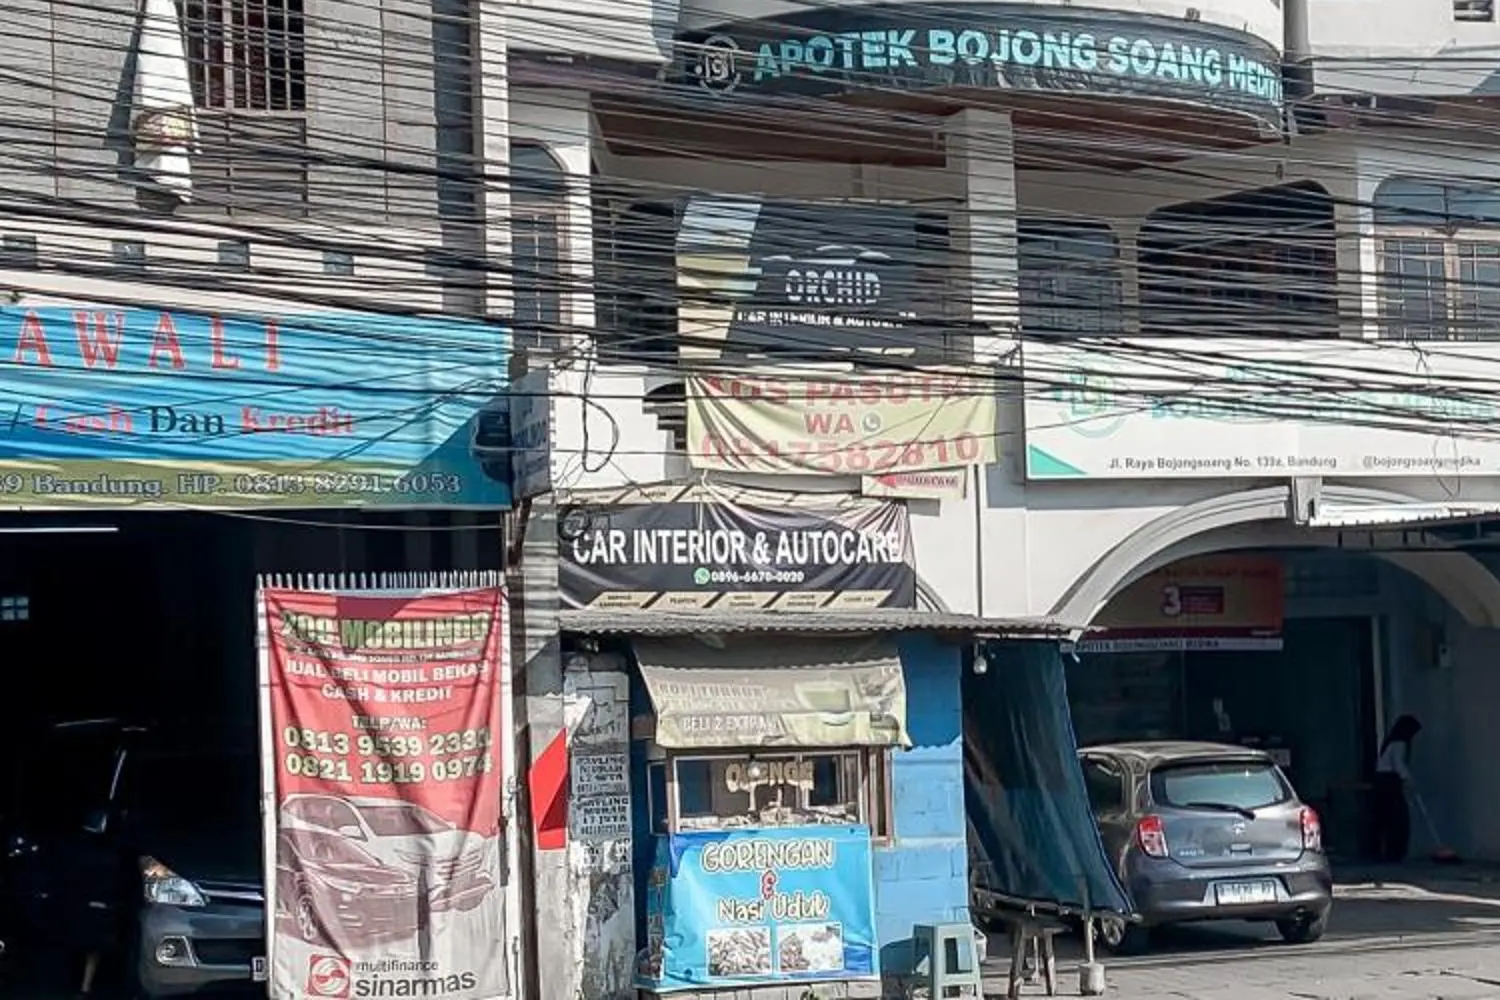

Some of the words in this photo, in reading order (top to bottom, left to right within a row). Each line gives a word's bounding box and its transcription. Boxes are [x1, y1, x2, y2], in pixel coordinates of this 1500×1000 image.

[753, 29, 918, 81] APOTEK
[930, 28, 1098, 70] BOJONG
[1107, 36, 1223, 87] SOANG
[150, 404, 224, 434] Dan
[804, 413, 854, 435] WA
[1126, 457, 1155, 470] Raya
[1288, 455, 1337, 470] Bandung
[573, 529, 627, 564] CAR
[633, 529, 748, 564] INTERIOR
[752, 534, 772, 565] &
[775, 530, 903, 564] AUTOCARE
[371, 666, 429, 684] MOBIL
[284, 725, 350, 756] 0813
[286, 752, 353, 783] 0821
[360, 760, 426, 784] 1919
[701, 837, 837, 874] GORENGAN
[716, 896, 768, 923] Nasi
[770, 889, 832, 921] Uduk
[354, 970, 477, 998] sinarmas
